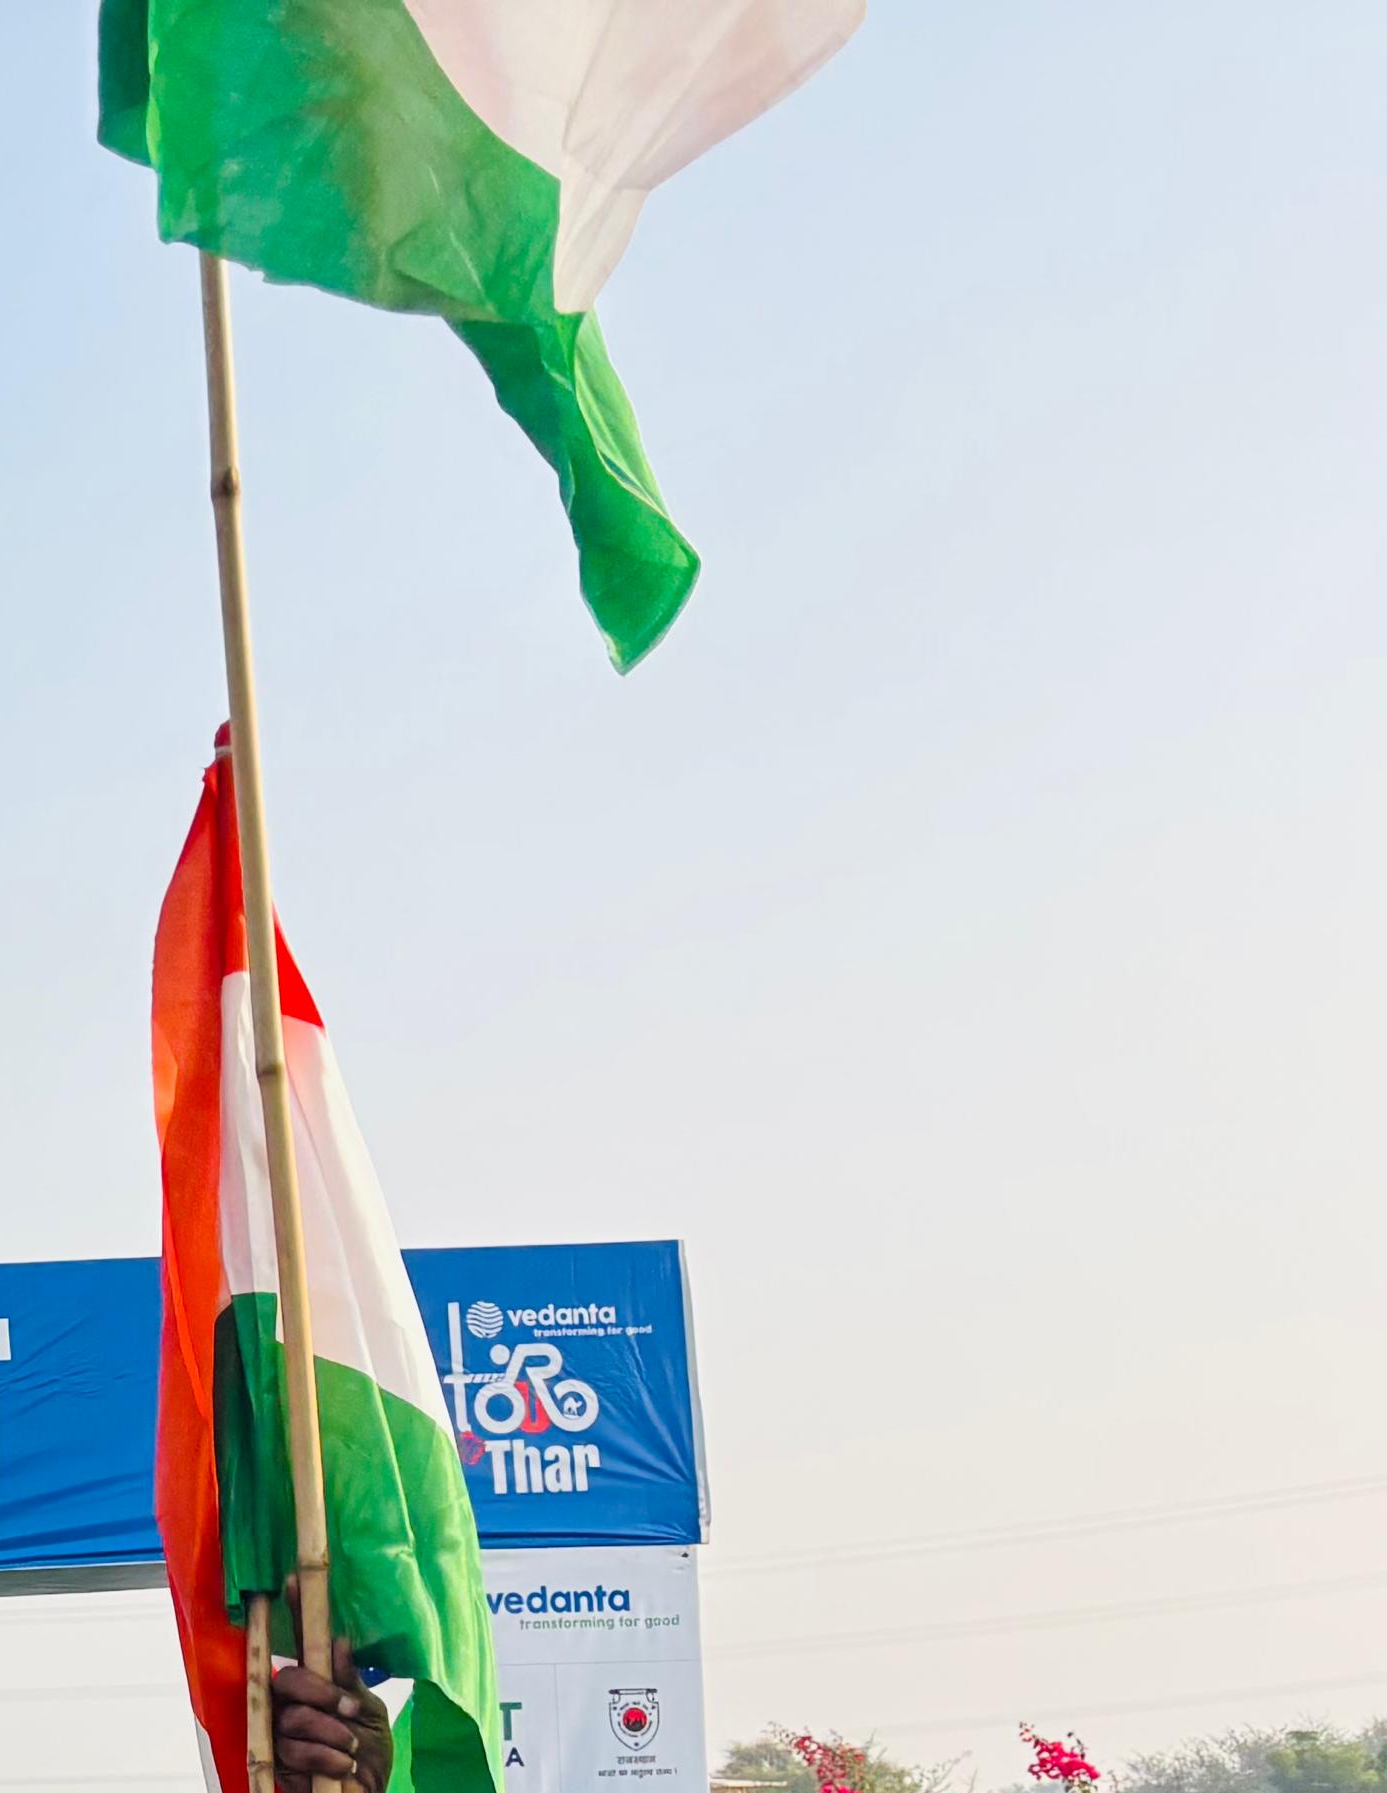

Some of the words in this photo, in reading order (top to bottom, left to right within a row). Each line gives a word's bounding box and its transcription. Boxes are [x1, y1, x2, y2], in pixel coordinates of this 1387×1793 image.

[507, 1304, 616, 1326] vedanta
[484, 1439, 601, 1494] Thar
[487, 1585, 630, 1614] vedanta
[520, 1617, 614, 1630] transforming
[619, 1616, 640, 1628] for
[645, 1614, 679, 1629] good
